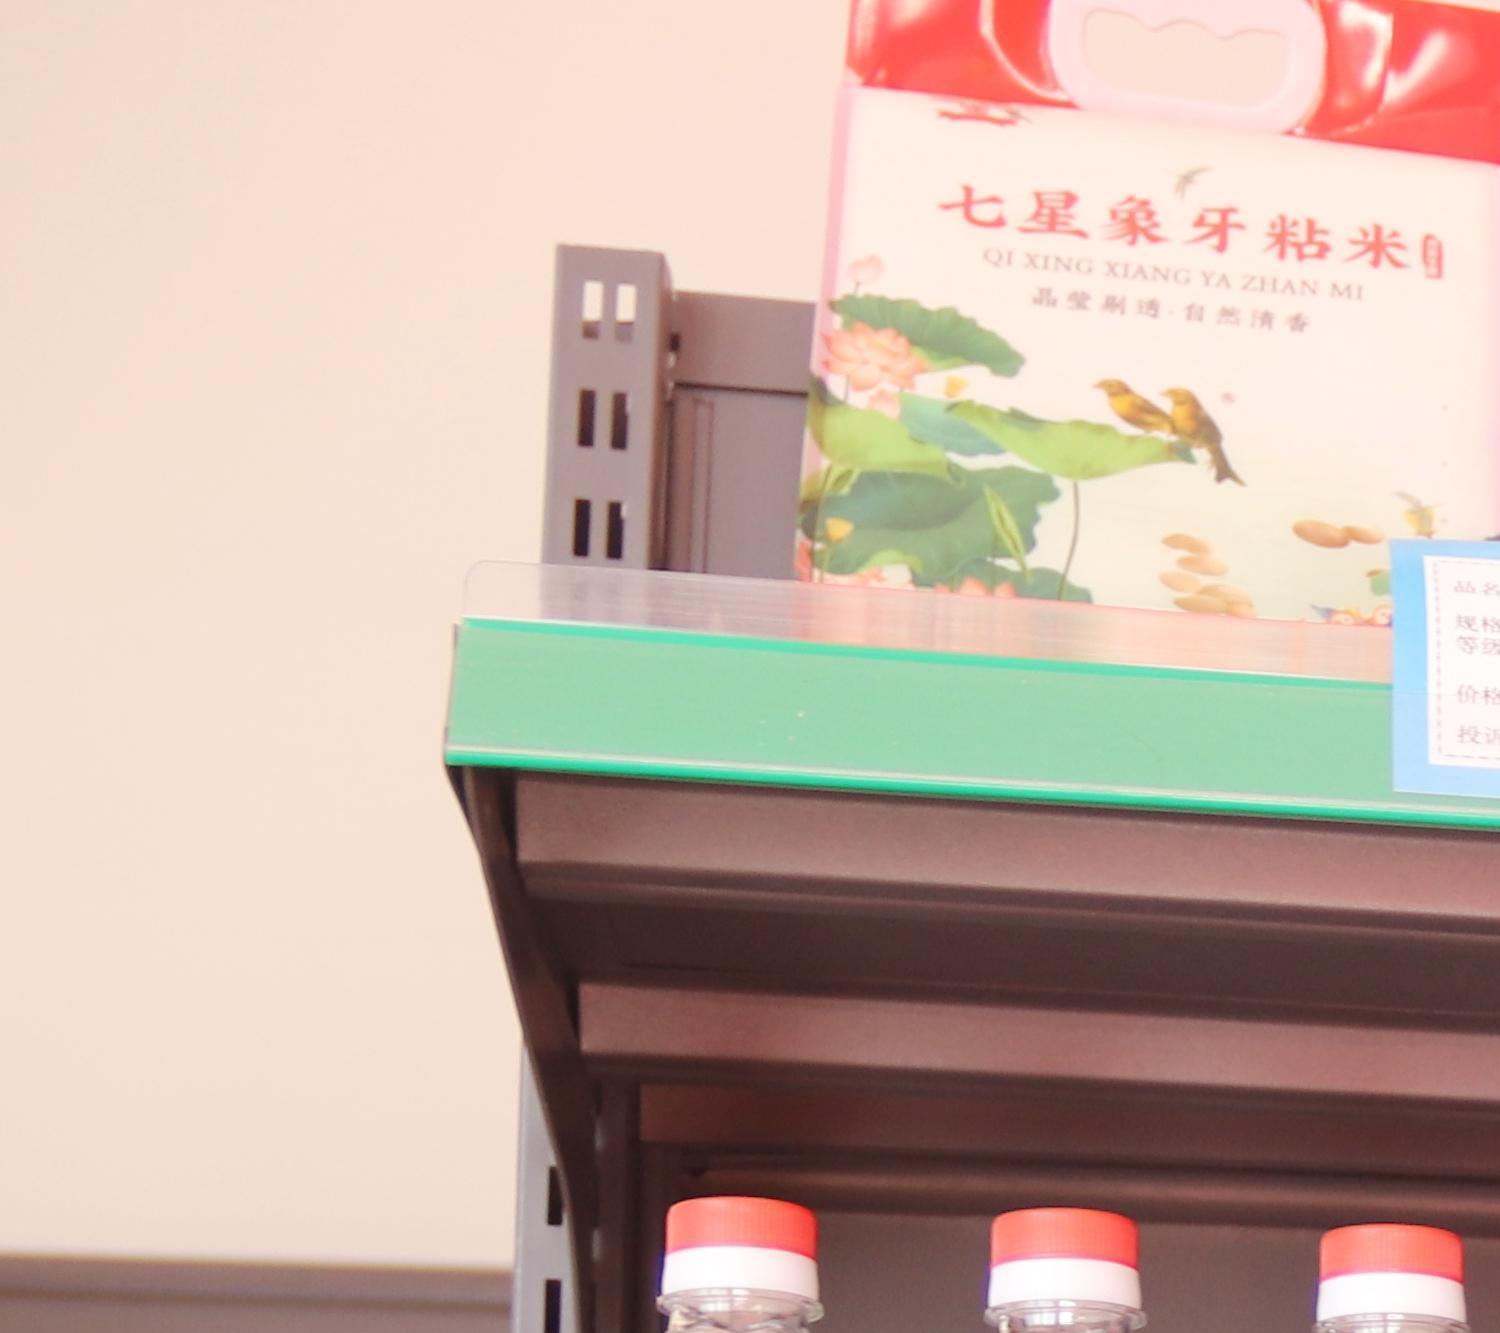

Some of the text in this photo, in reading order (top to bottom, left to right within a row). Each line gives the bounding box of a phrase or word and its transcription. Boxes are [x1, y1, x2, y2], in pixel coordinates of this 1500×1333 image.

[938, 184, 1411, 271] 七星象牙粘米
[982, 248, 1365, 302] QI XING XIANG YA ZHAN MI
